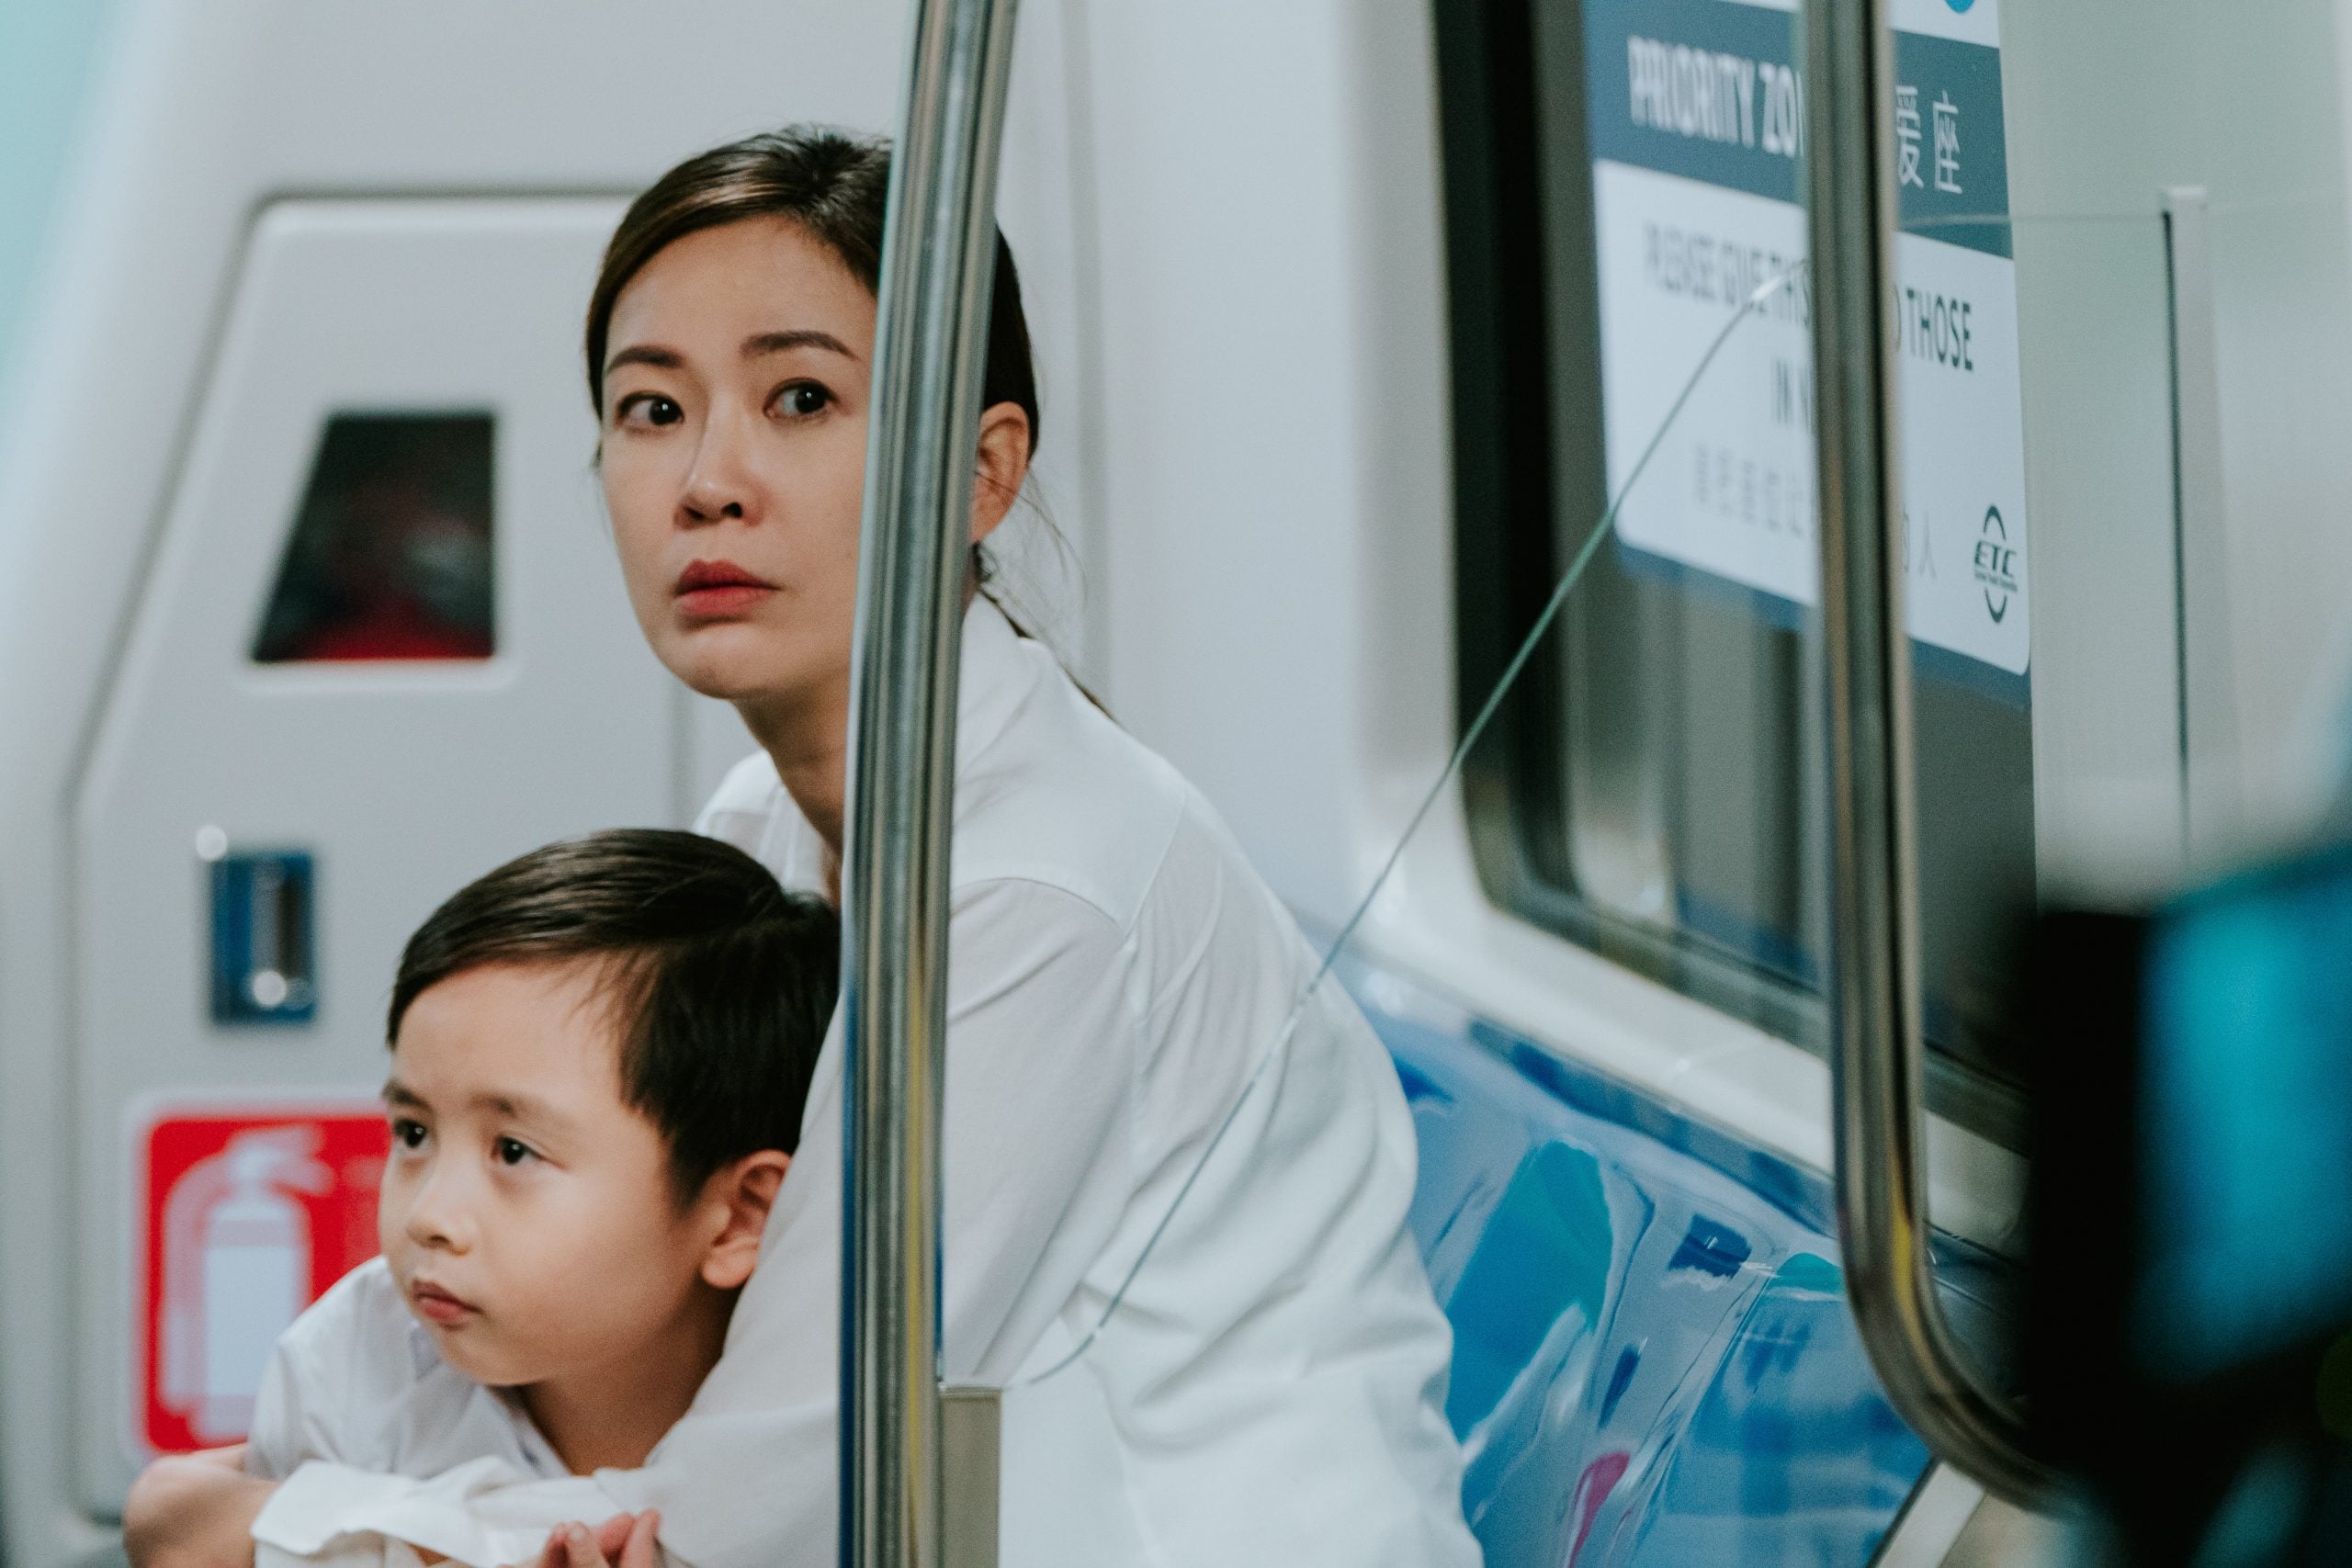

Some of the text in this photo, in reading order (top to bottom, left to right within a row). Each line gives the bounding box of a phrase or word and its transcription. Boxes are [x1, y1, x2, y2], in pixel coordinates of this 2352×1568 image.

[1628, 35, 1755, 149] PRIORITY
[1905, 287, 1973, 371] THOSE
[1974, 539, 2018, 579] ETC
